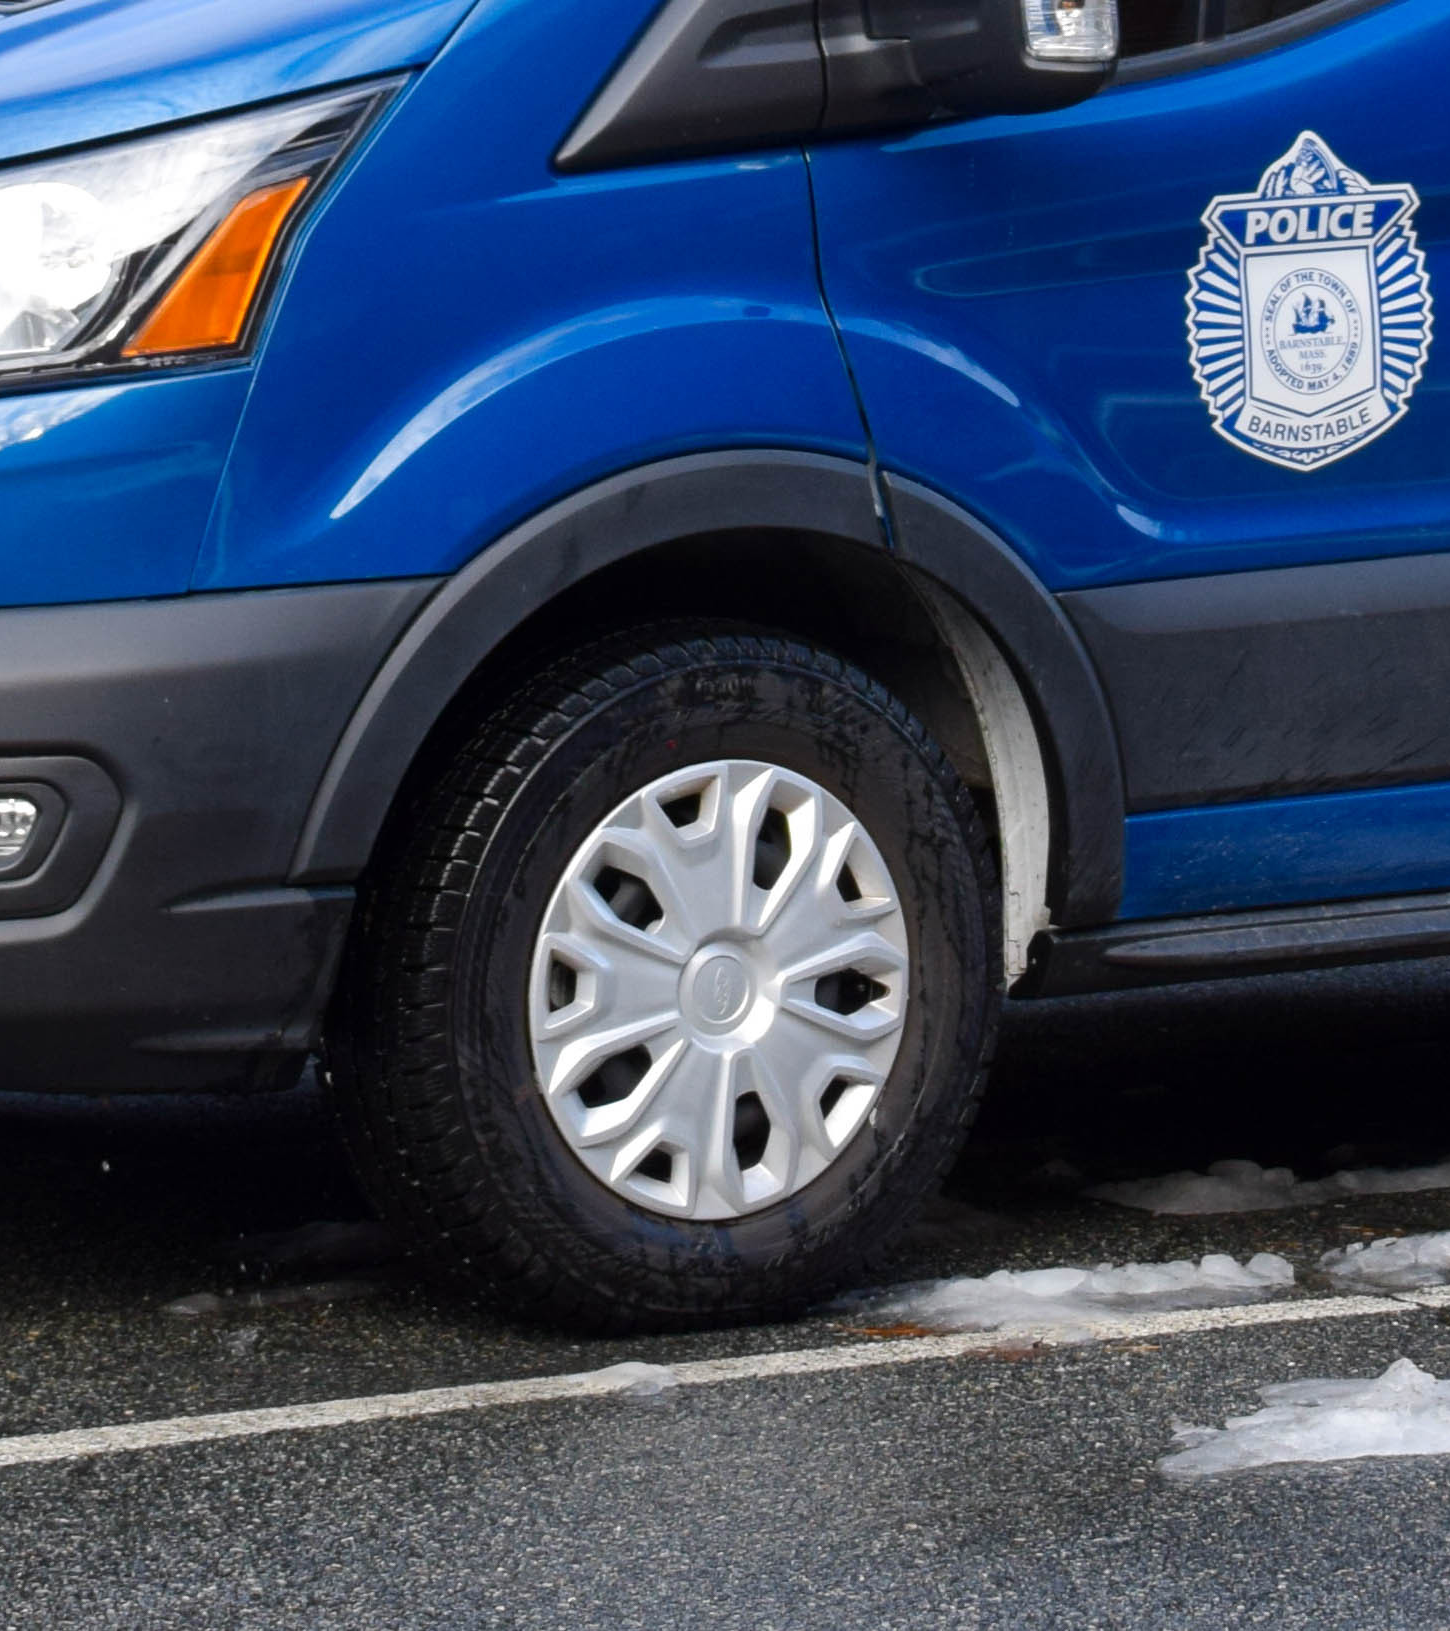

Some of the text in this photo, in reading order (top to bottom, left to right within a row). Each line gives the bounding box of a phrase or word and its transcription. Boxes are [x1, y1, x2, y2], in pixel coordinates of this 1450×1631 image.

[1244, 202, 1376, 245] POLICE
[1264, 271, 1357, 323] SEAL OF THE TOWN OF
[1266, 349, 1304, 390] ADOPTED
[1307, 378, 1329, 391] MAY
[1247, 407, 1372, 443] BARNSTABLE
